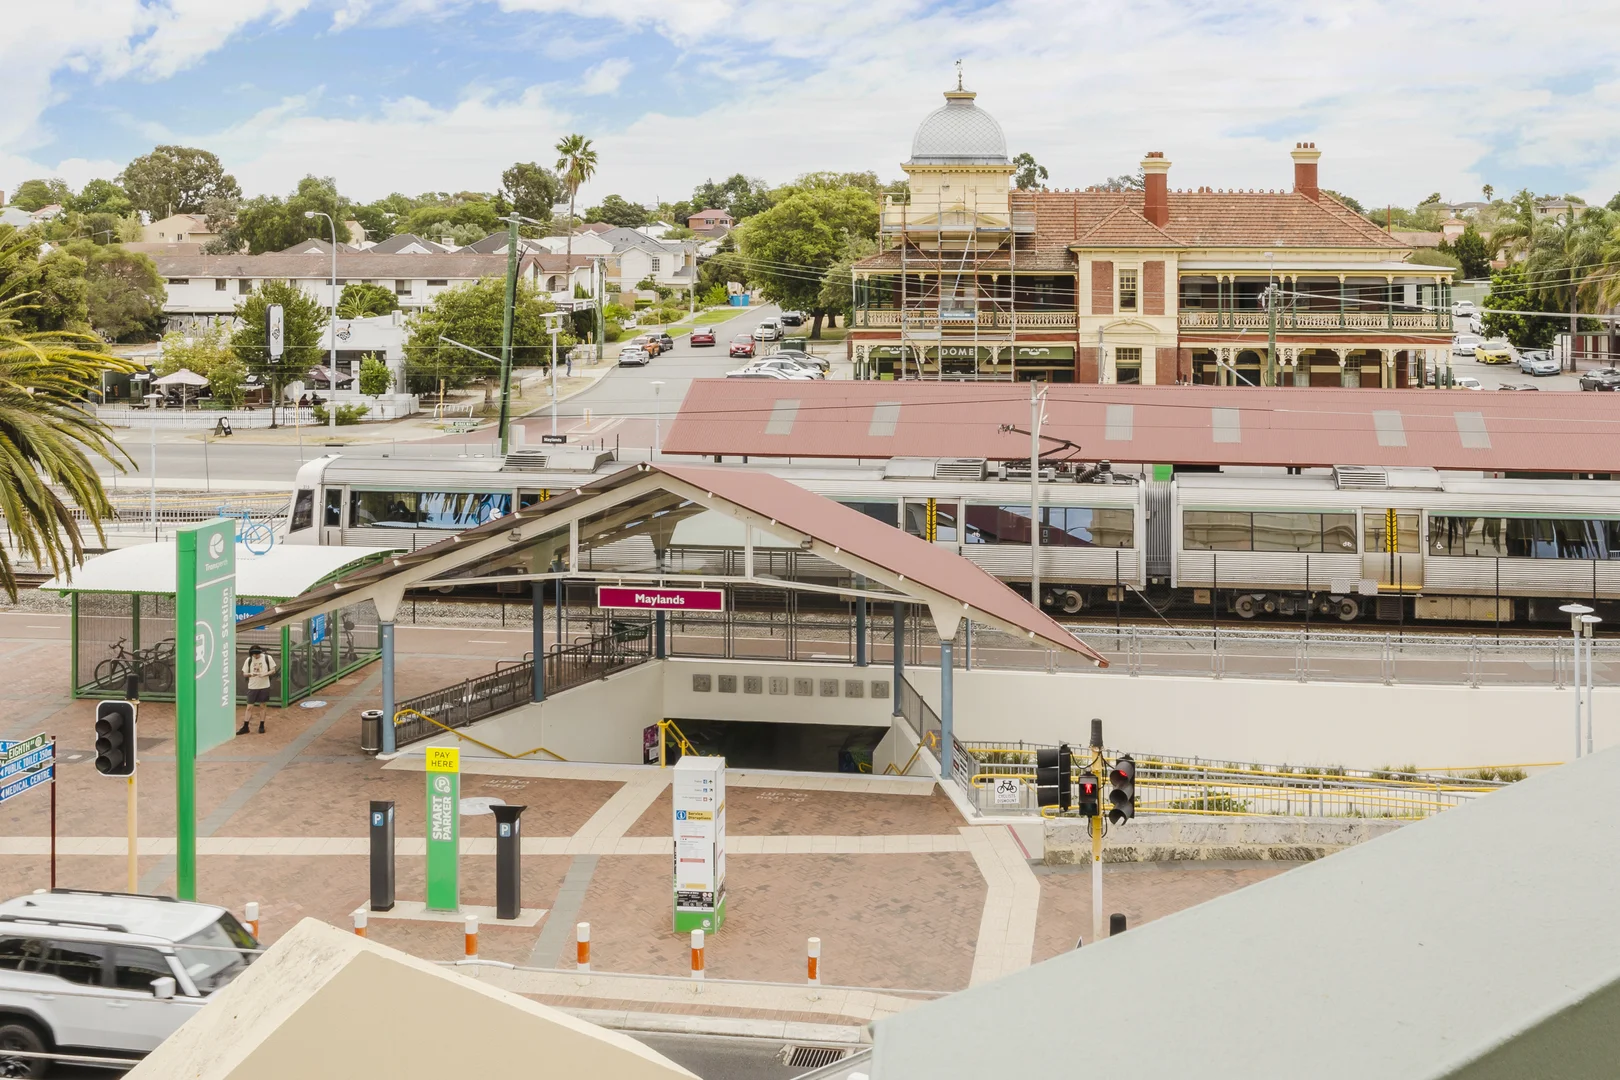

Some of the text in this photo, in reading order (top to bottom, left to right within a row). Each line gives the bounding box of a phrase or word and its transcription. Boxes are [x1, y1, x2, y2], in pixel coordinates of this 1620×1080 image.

[942, 347, 974, 356] DÔME
[635, 594, 685, 606] Maylands
[222, 642, 230, 707] Maylands
[8, 741, 31, 760] EIGHTH
[5, 760, 22, 777] PUBLIC
[23, 753, 39, 767] TOILET
[431, 760, 453, 768] HERE
[5, 769, 50, 797] MEDICAL CENTRE
[432, 795, 443, 840] SMART
[442, 796, 452, 841] PARKER
